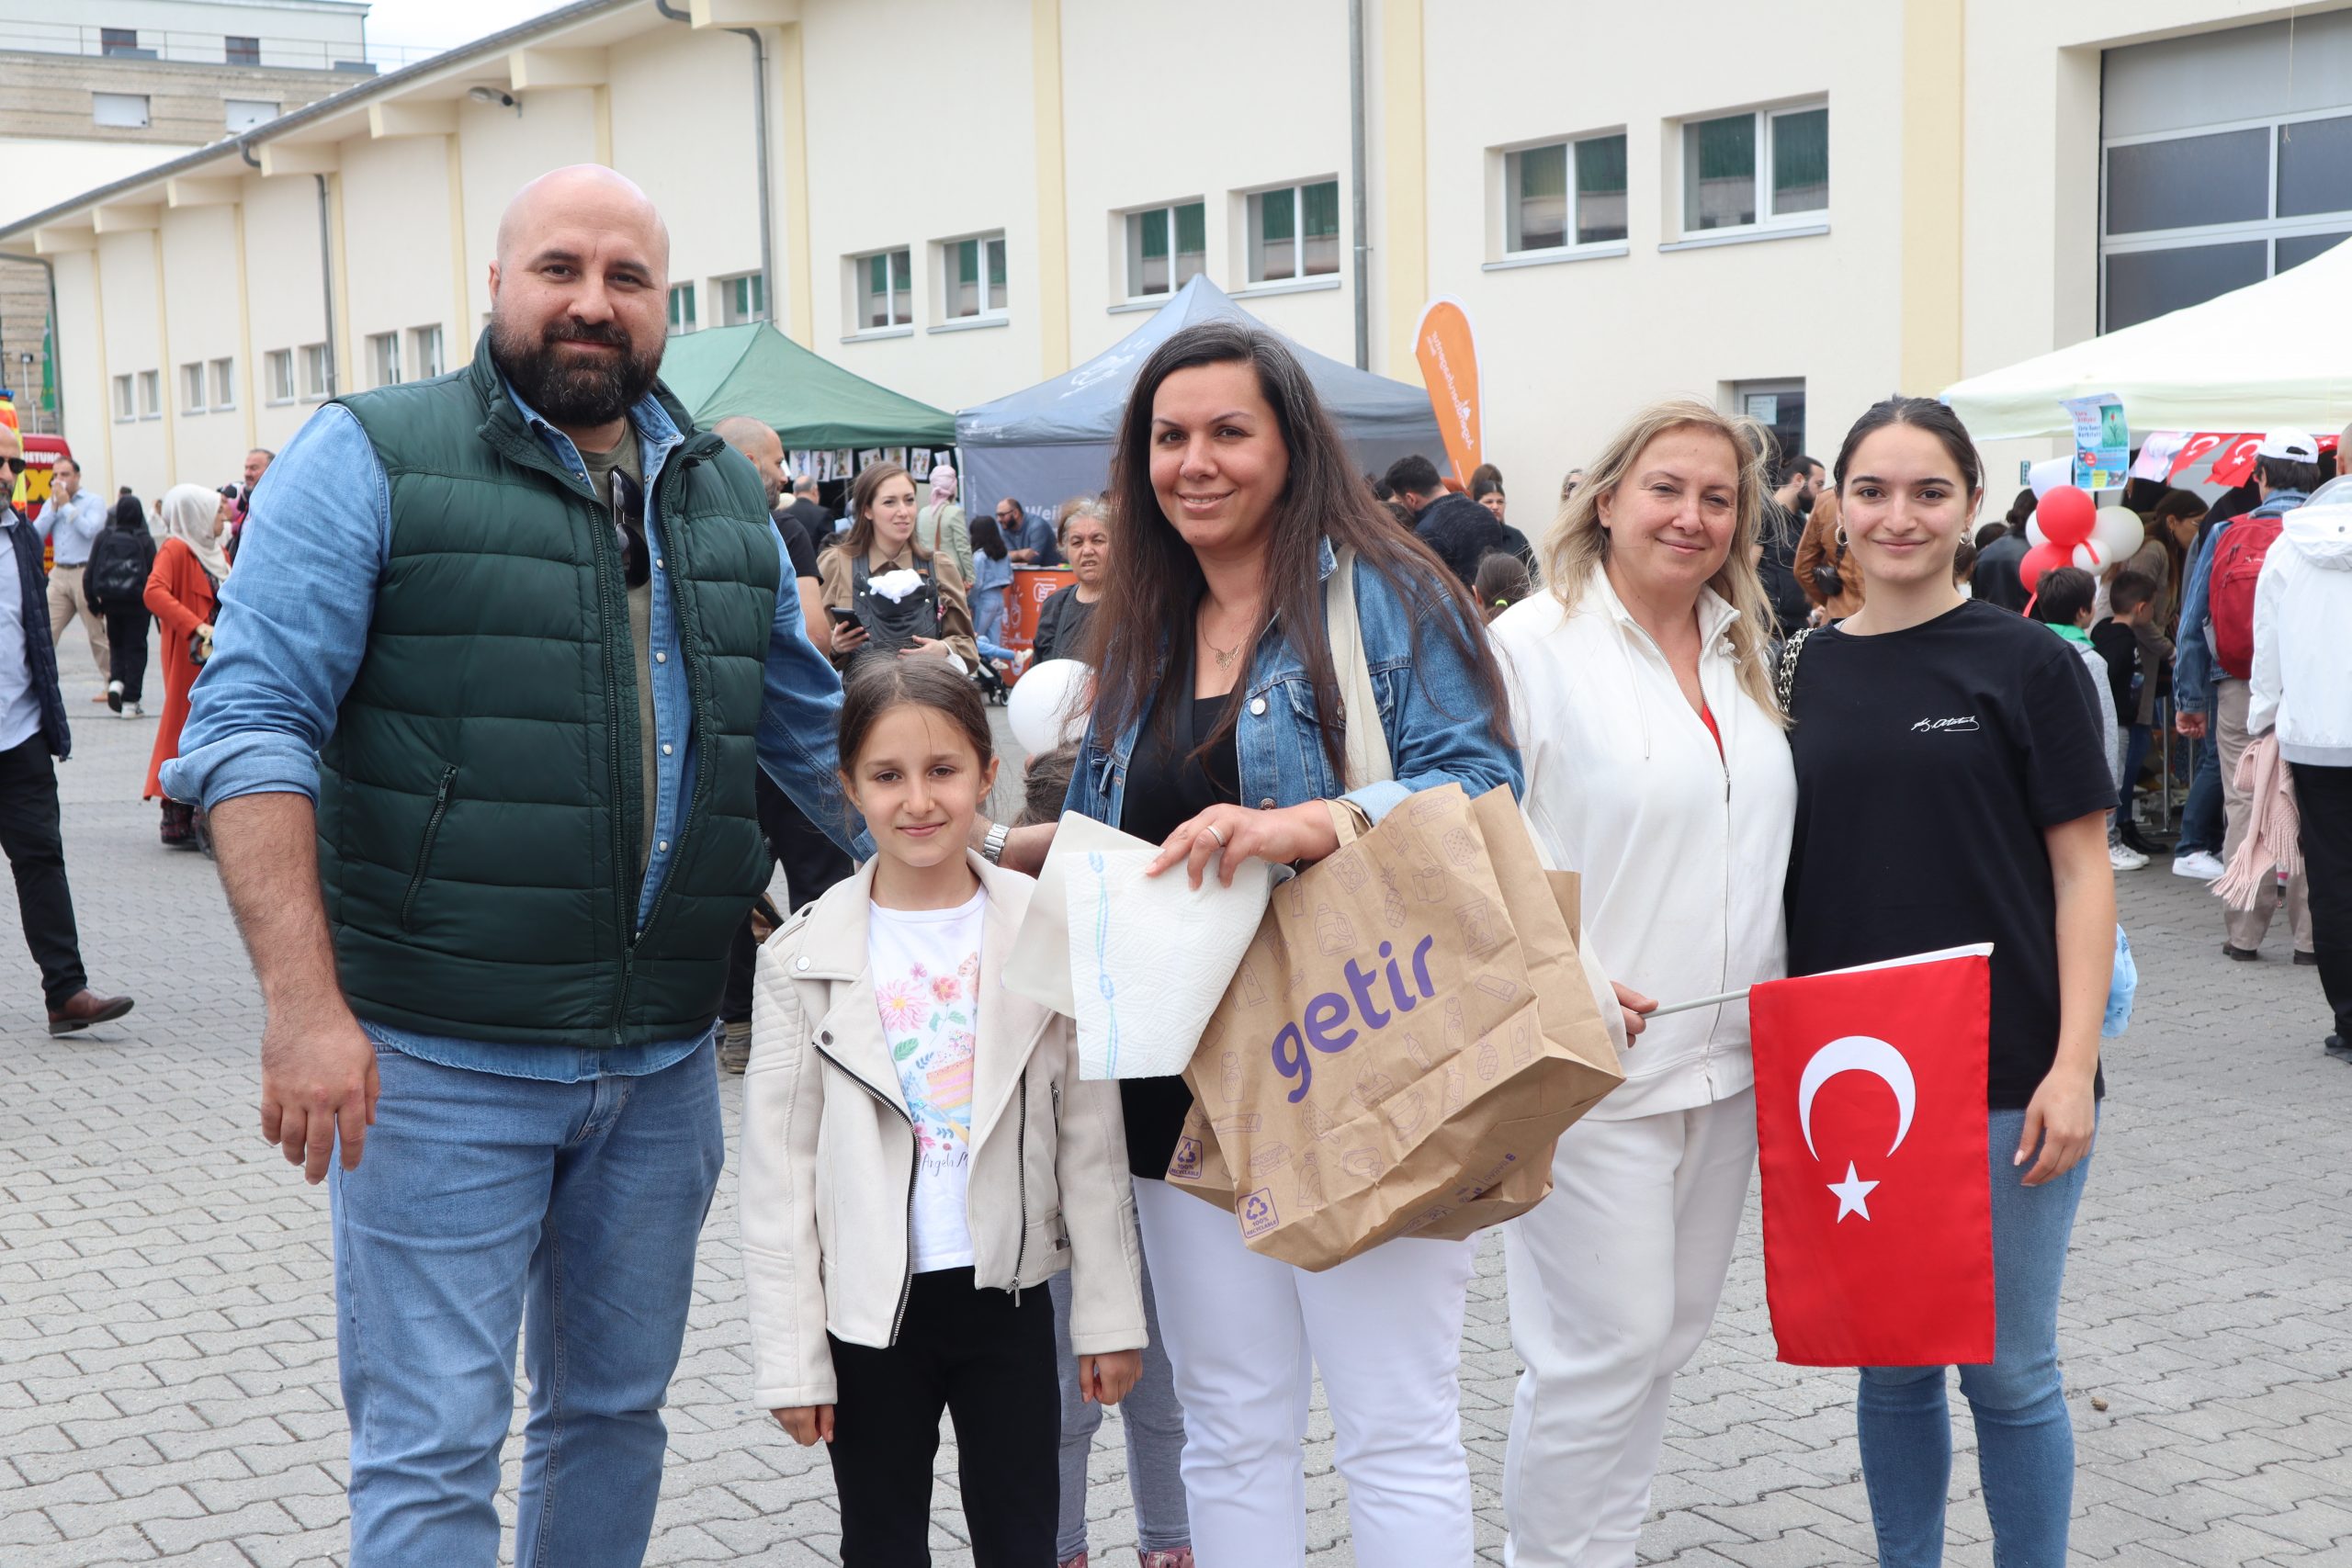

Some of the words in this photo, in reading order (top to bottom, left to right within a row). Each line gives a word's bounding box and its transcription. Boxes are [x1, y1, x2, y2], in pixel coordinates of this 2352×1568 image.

[1272, 934, 1435, 1103] getir
[1170, 1168, 1199, 1177] RECYCLABLE
[1246, 1220, 1277, 1236] RECYCLABLE
[1252, 1217, 1270, 1227] 100%
